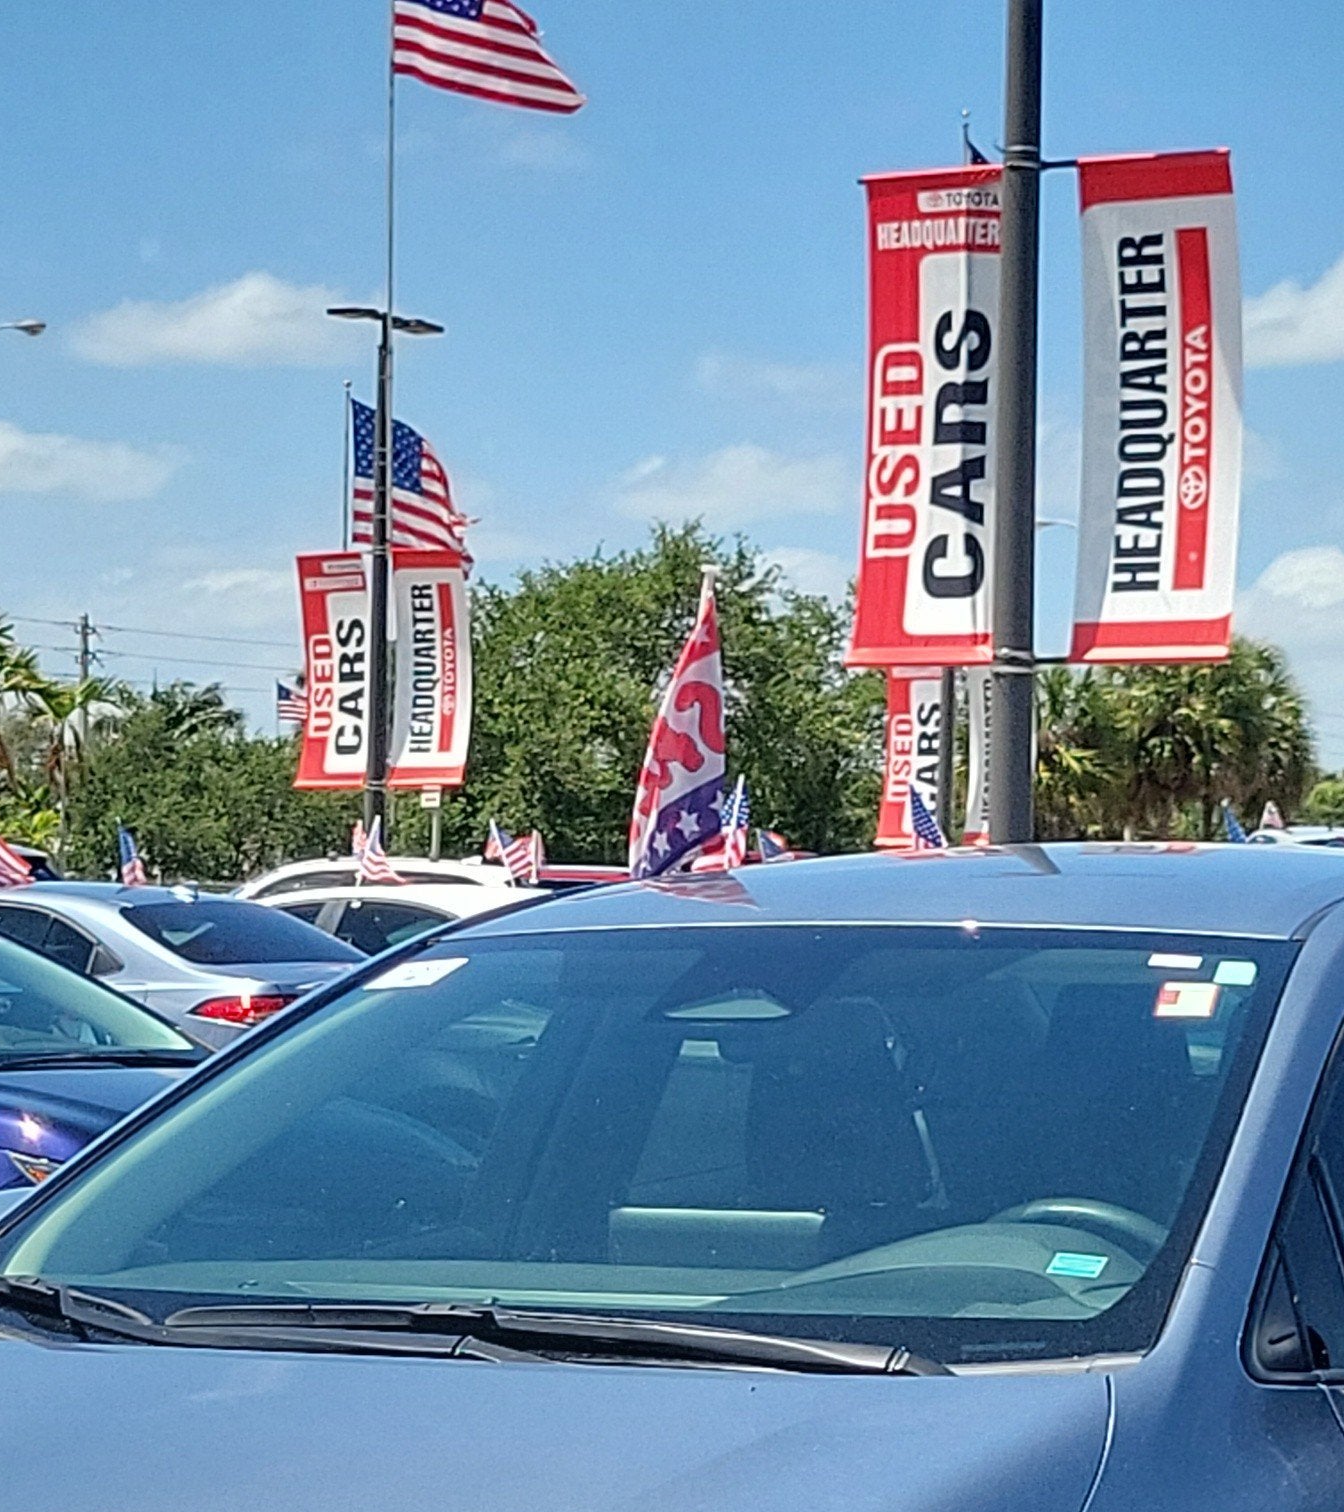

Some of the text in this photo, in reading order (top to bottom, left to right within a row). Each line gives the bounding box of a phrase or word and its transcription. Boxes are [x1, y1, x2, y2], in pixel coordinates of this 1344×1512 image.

[945, 192, 999, 206] TOYOTA
[871, 310, 992, 599] USED CARS
[1111, 232, 1174, 593] HEADQUARTER
[1183, 324, 1208, 463] TOYOTA
[313, 617, 365, 756] USED CARS
[408, 583, 440, 754] HEADQUARTER
[442, 627, 455, 699] TOYOTA
[891, 717, 913, 798] USED
